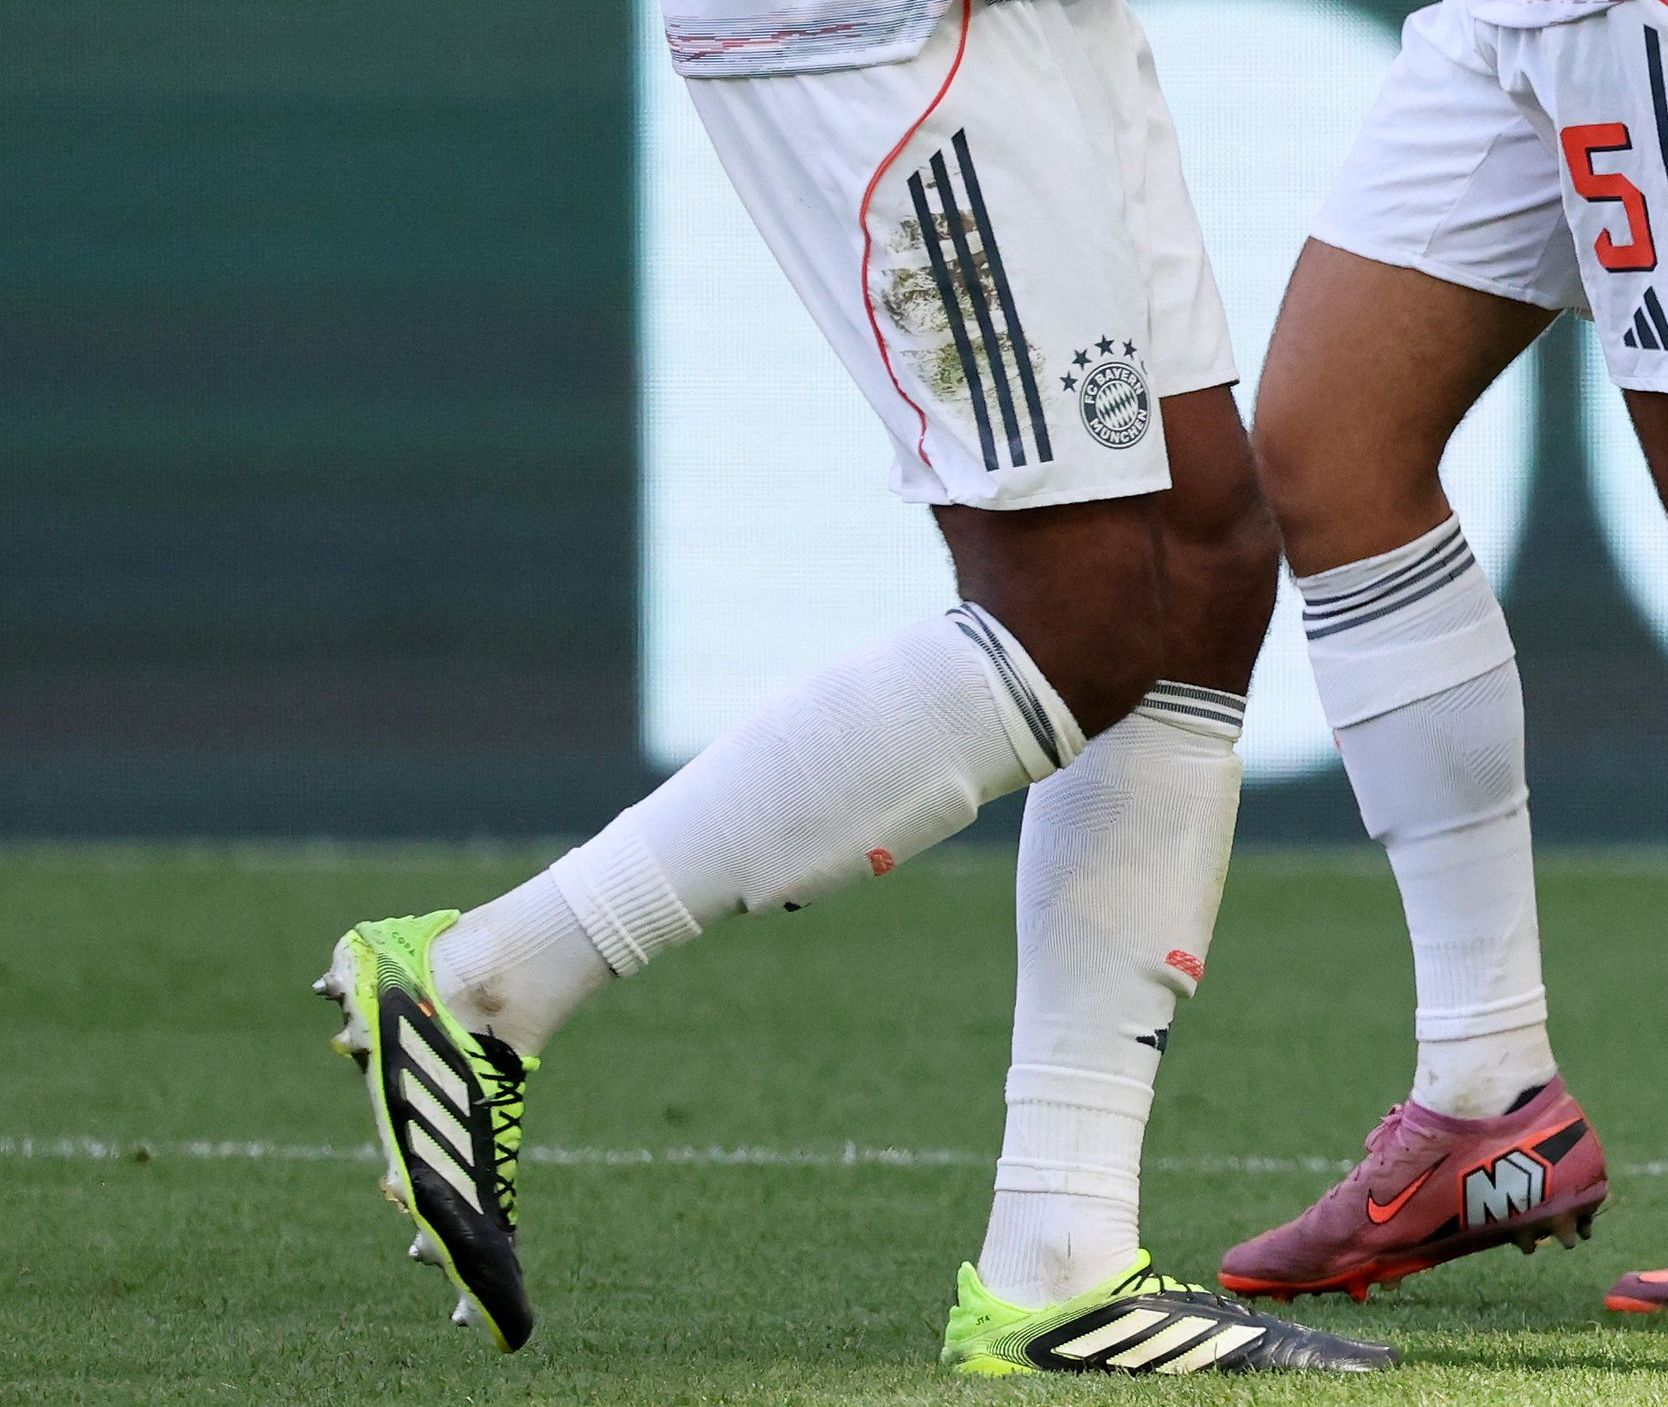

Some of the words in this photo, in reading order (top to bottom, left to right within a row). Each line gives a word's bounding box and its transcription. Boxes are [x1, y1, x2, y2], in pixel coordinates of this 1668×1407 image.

[1558, 121, 1657, 273] 5
[1084, 384, 1098, 405] FC
[1095, 367, 1145, 395] BAYERN
